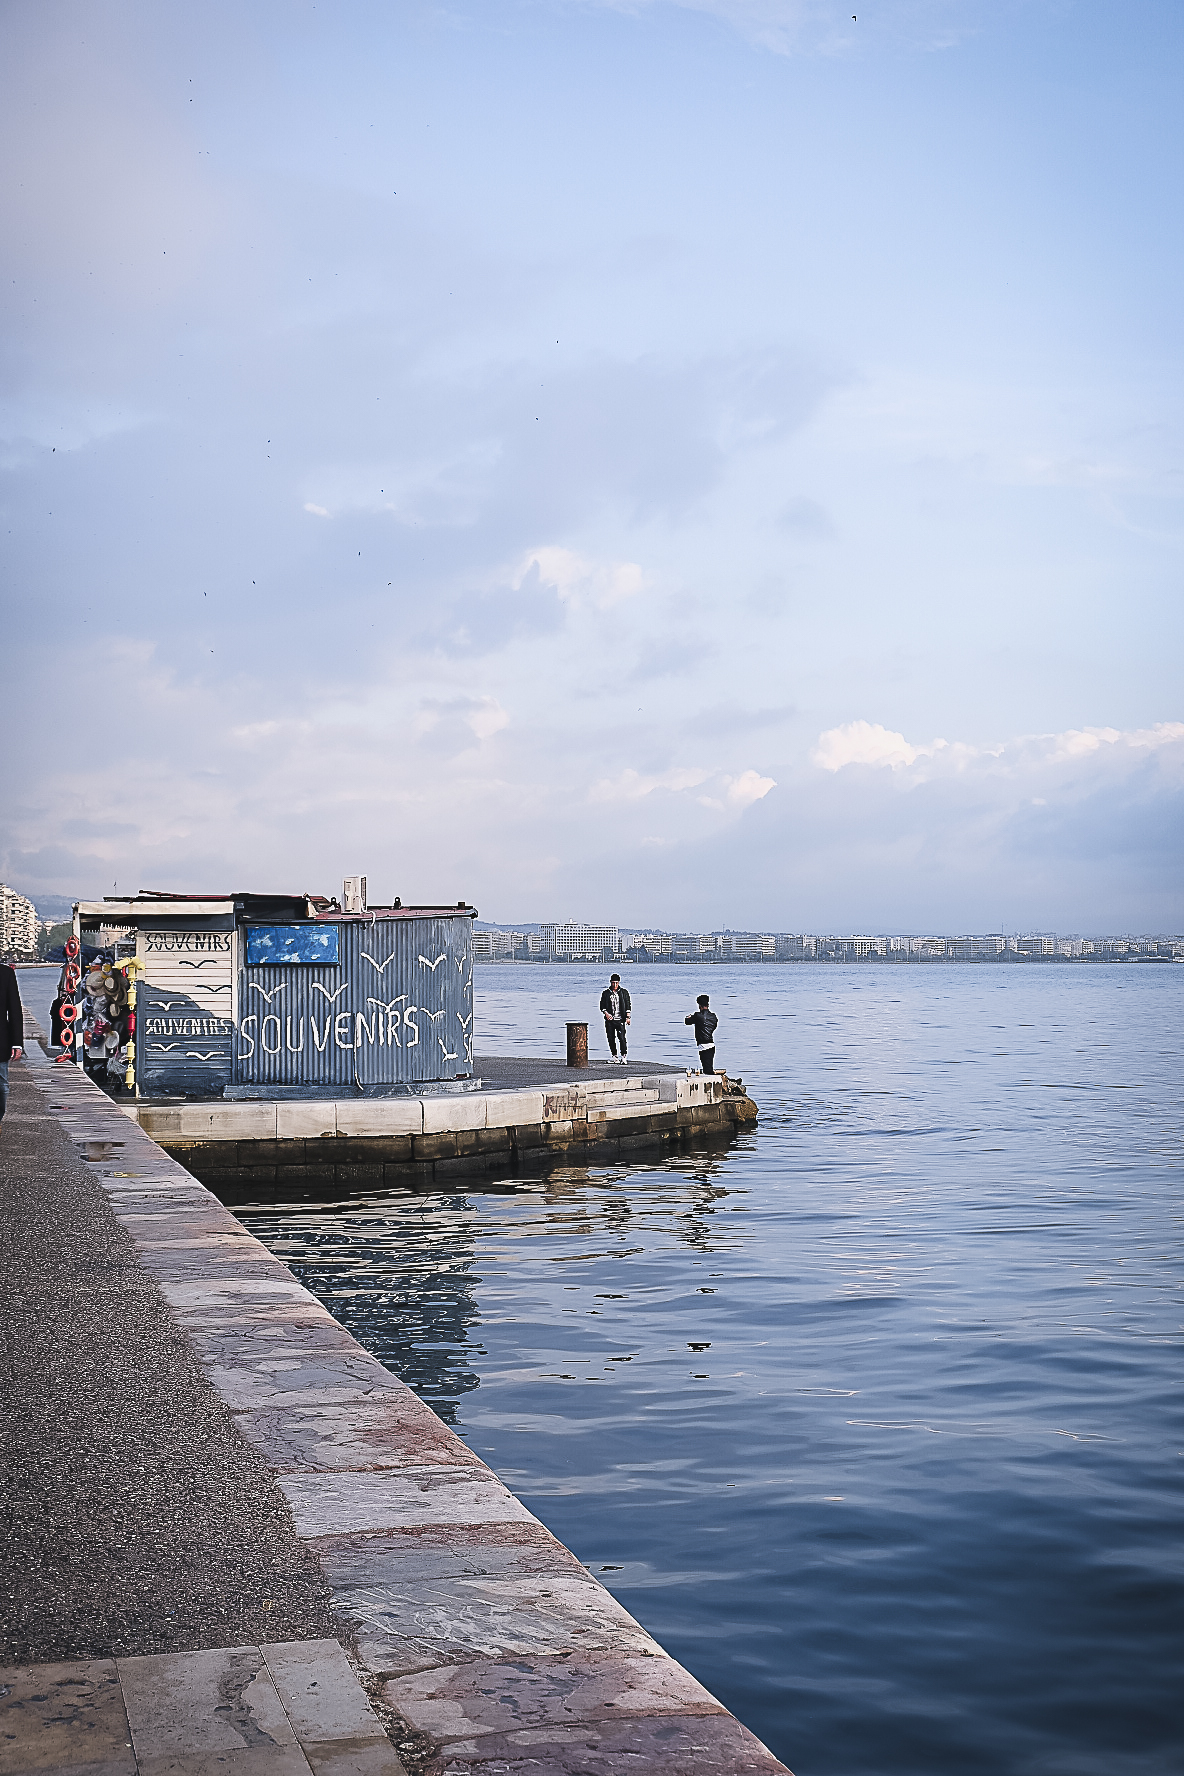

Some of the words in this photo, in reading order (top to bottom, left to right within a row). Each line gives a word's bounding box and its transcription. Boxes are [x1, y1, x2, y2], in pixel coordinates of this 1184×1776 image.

[145, 933, 230, 952] SOUVENIRS
[145, 1018, 231, 1035] SOUVENIRS
[238, 1006, 420, 1059] SOUVENIRS
